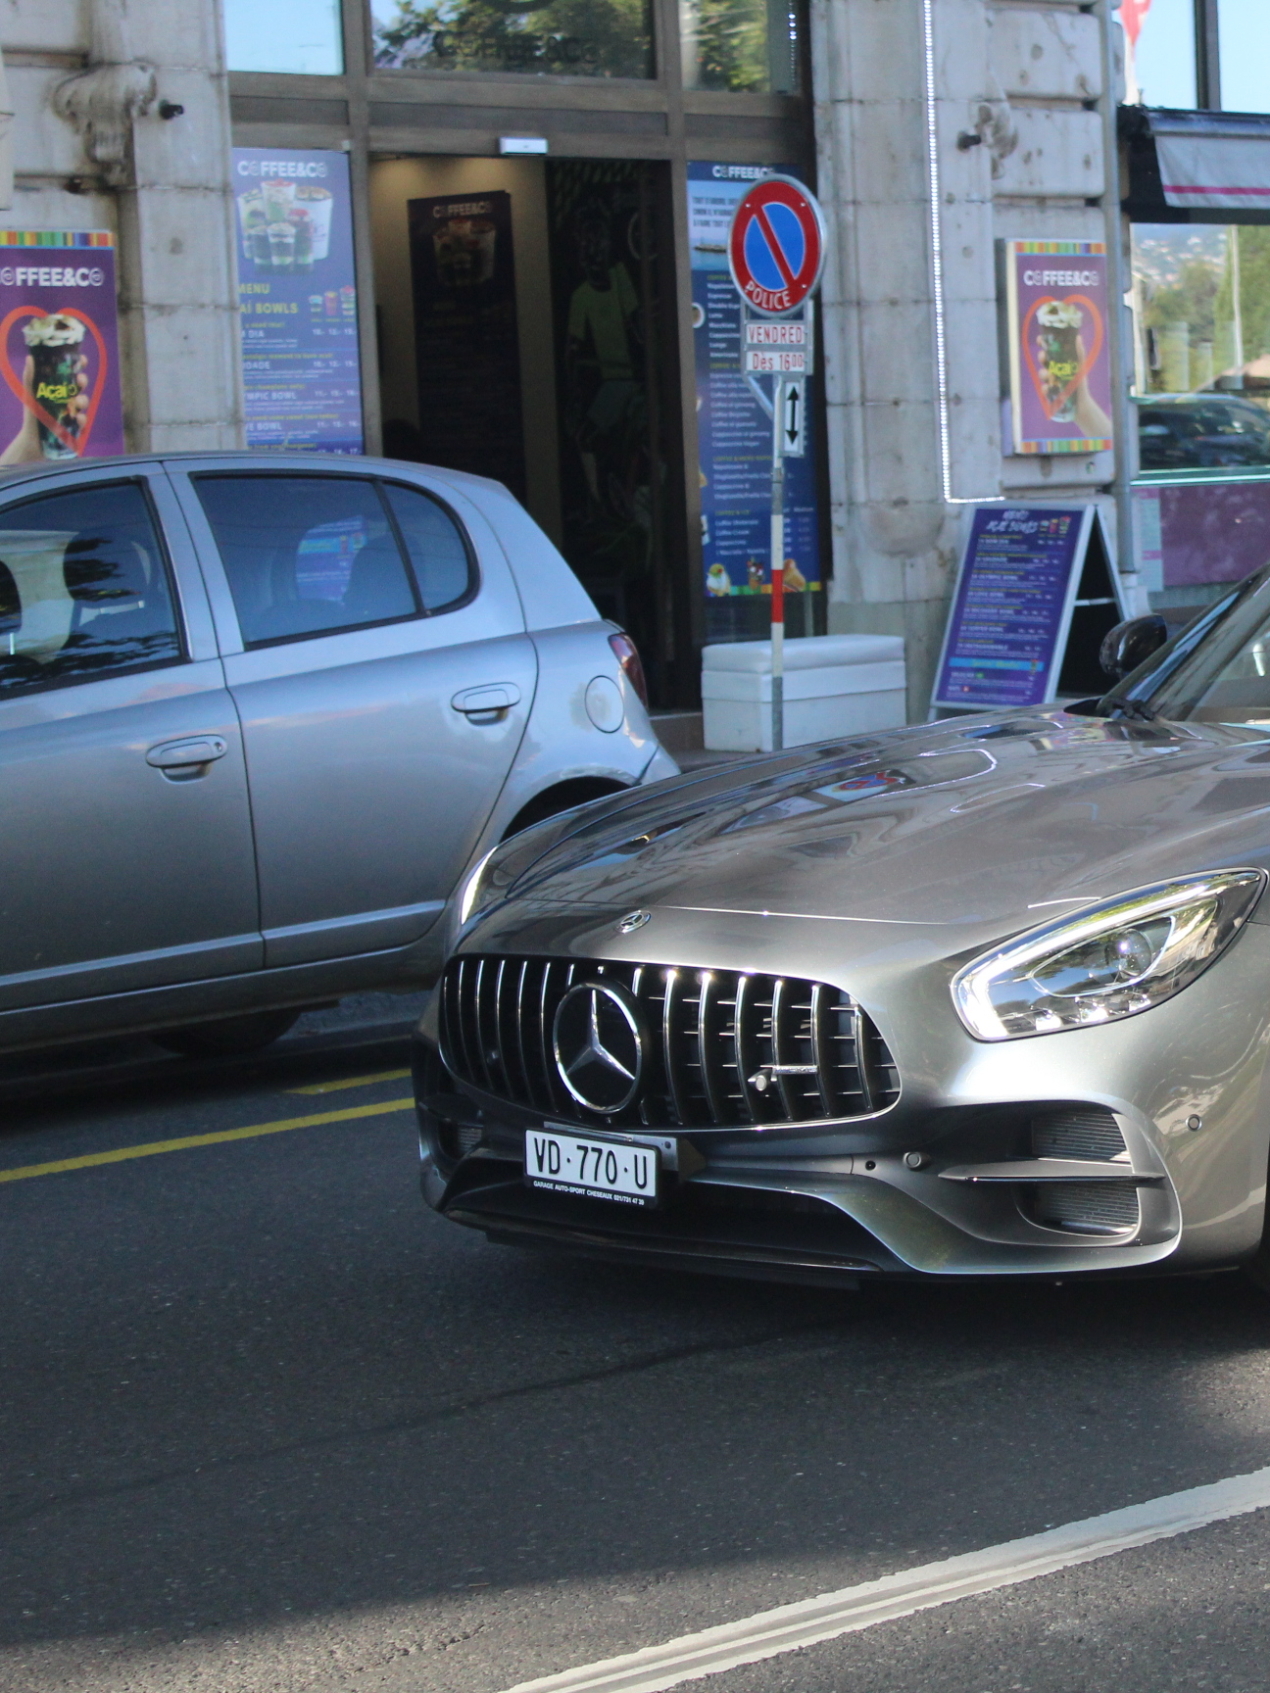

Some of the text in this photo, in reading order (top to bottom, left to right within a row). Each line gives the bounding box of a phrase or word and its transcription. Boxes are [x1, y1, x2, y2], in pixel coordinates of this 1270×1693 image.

[0, 266, 104, 287] OFFEE&CO
[1023, 270, 1100, 286] COFFEE&CO
[745, 280, 792, 309] POLICE
[255, 302, 298, 314] BOWLS
[753, 351, 774, 371] Dès
[533, 1180, 554, 1189] GARAGE
[555, 1185, 586, 1195] AUTO-SPORT
[587, 1189, 613, 1199] CHESEAUX
